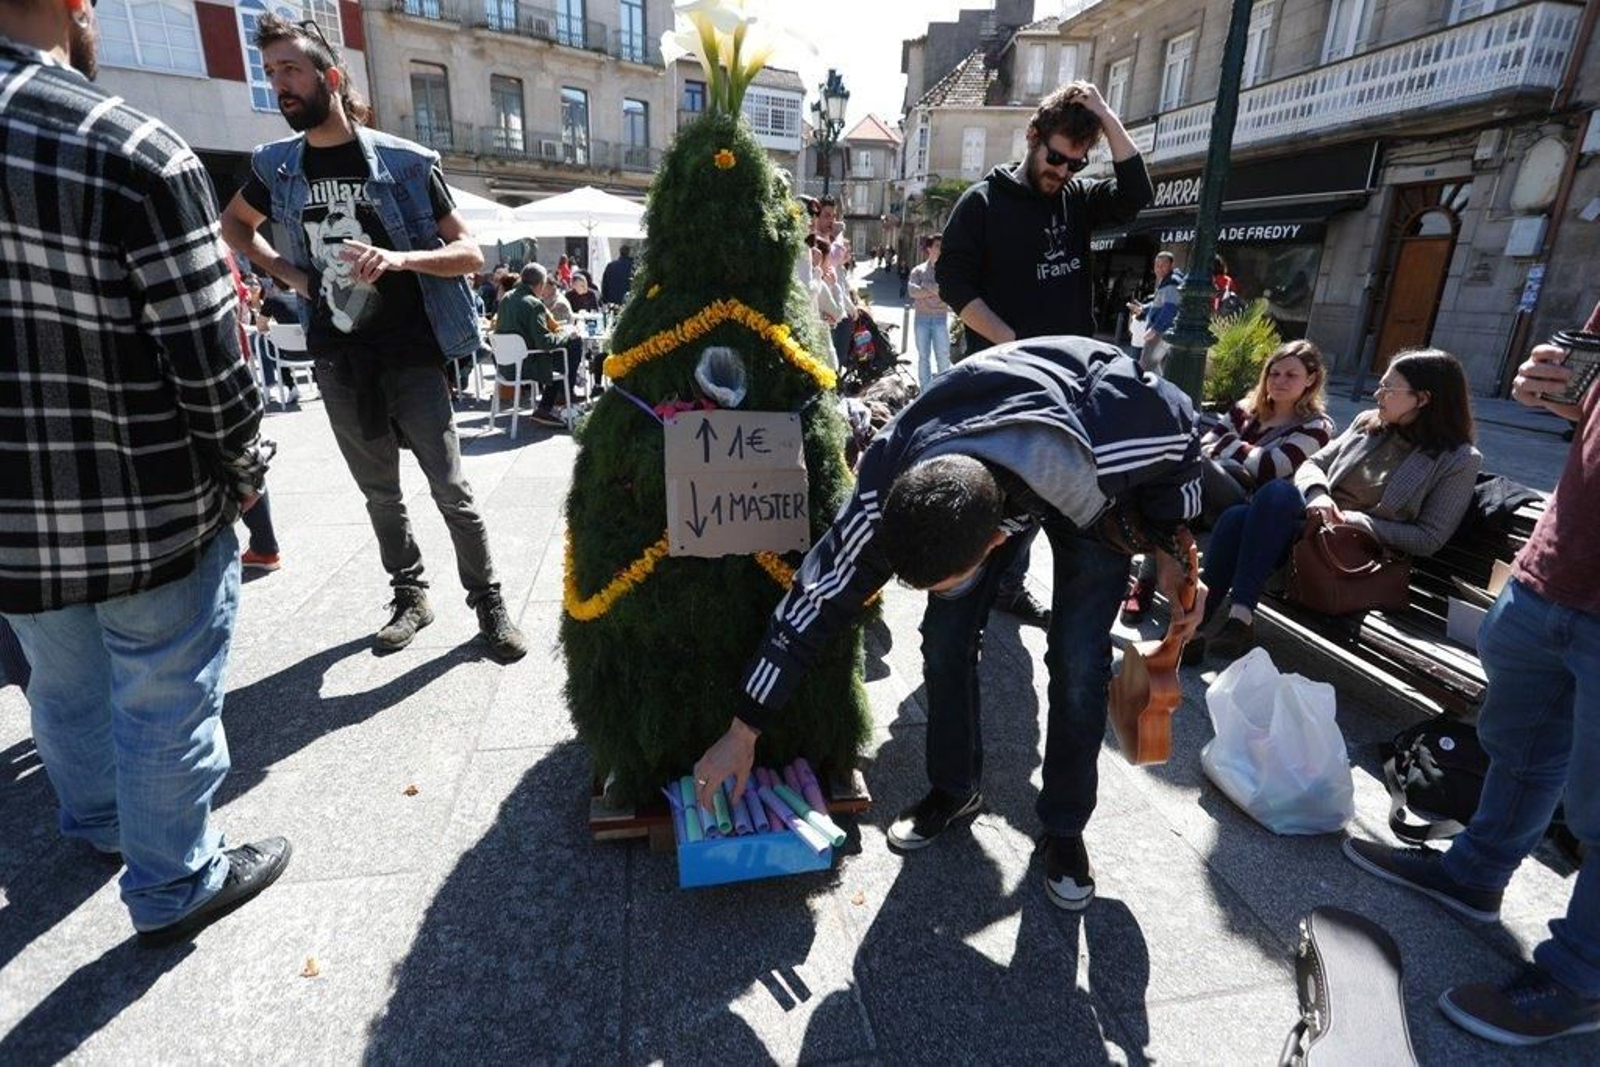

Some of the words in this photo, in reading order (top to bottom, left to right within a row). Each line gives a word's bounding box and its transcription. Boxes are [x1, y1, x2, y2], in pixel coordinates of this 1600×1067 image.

[1154, 176, 1201, 206] BARRA
[1090, 238, 1115, 251] REDYY
[1161, 231, 1173, 243] LA
[1228, 227, 1246, 240] DE
[1246, 224, 1301, 240] FREDYY
[711, 495, 722, 525] 1
[729, 481, 806, 522] MÁSTER
